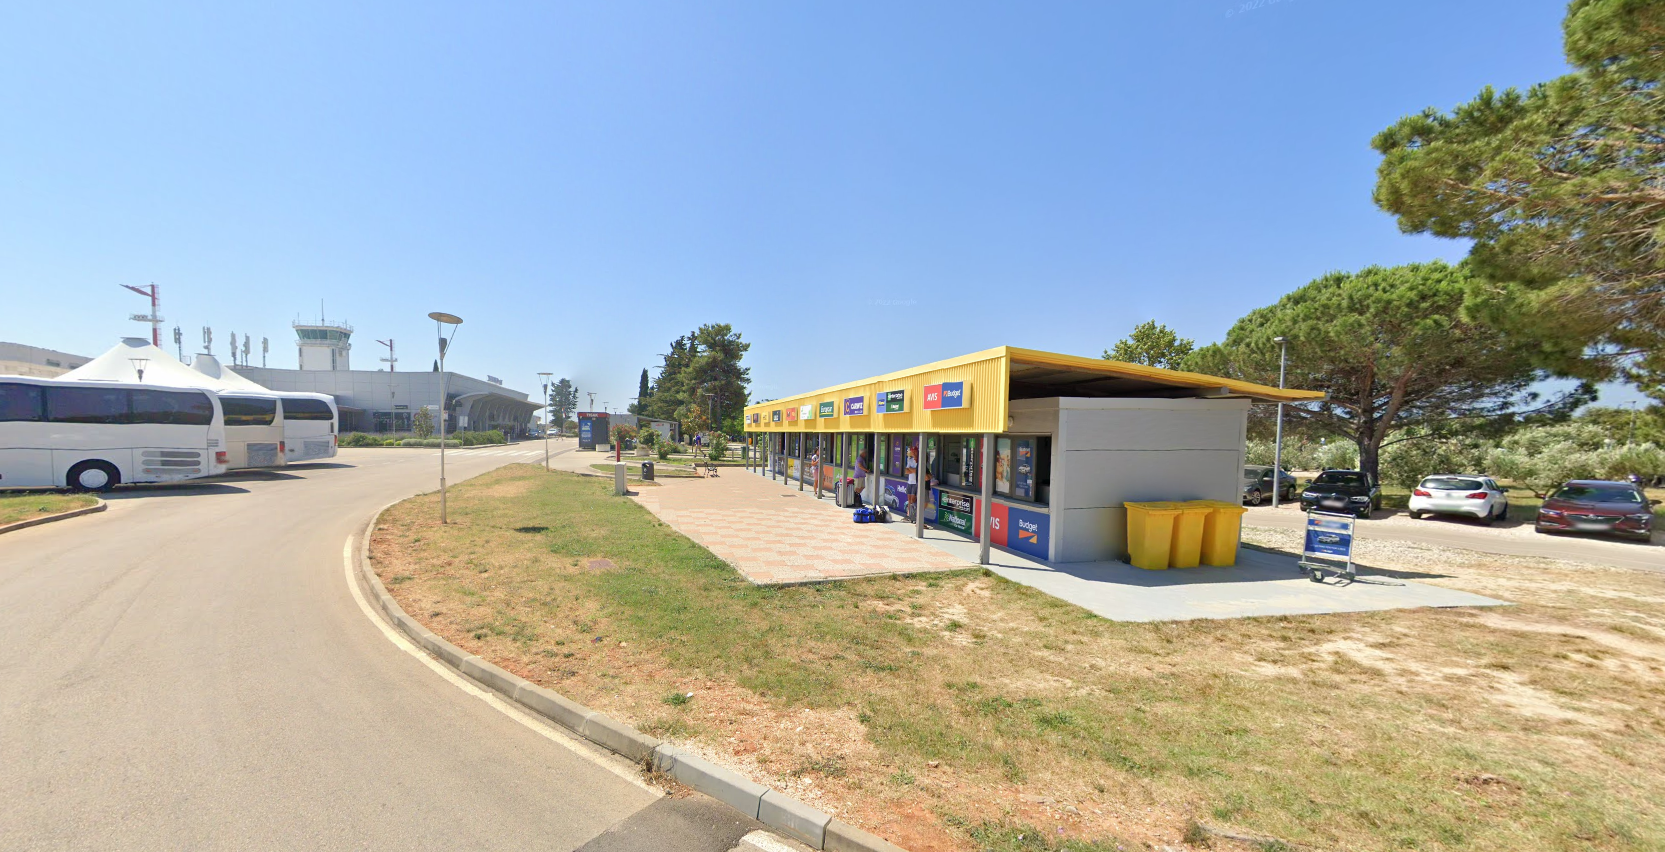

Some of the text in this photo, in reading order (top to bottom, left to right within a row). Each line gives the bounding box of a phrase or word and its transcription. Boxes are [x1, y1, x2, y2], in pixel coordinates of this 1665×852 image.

[927, 392, 938, 401] AVIS
[947, 390, 961, 399] Budget
[942, 497, 970, 509] enterprise
[948, 514, 967, 526] National
[1018, 519, 1038, 532] Budget
